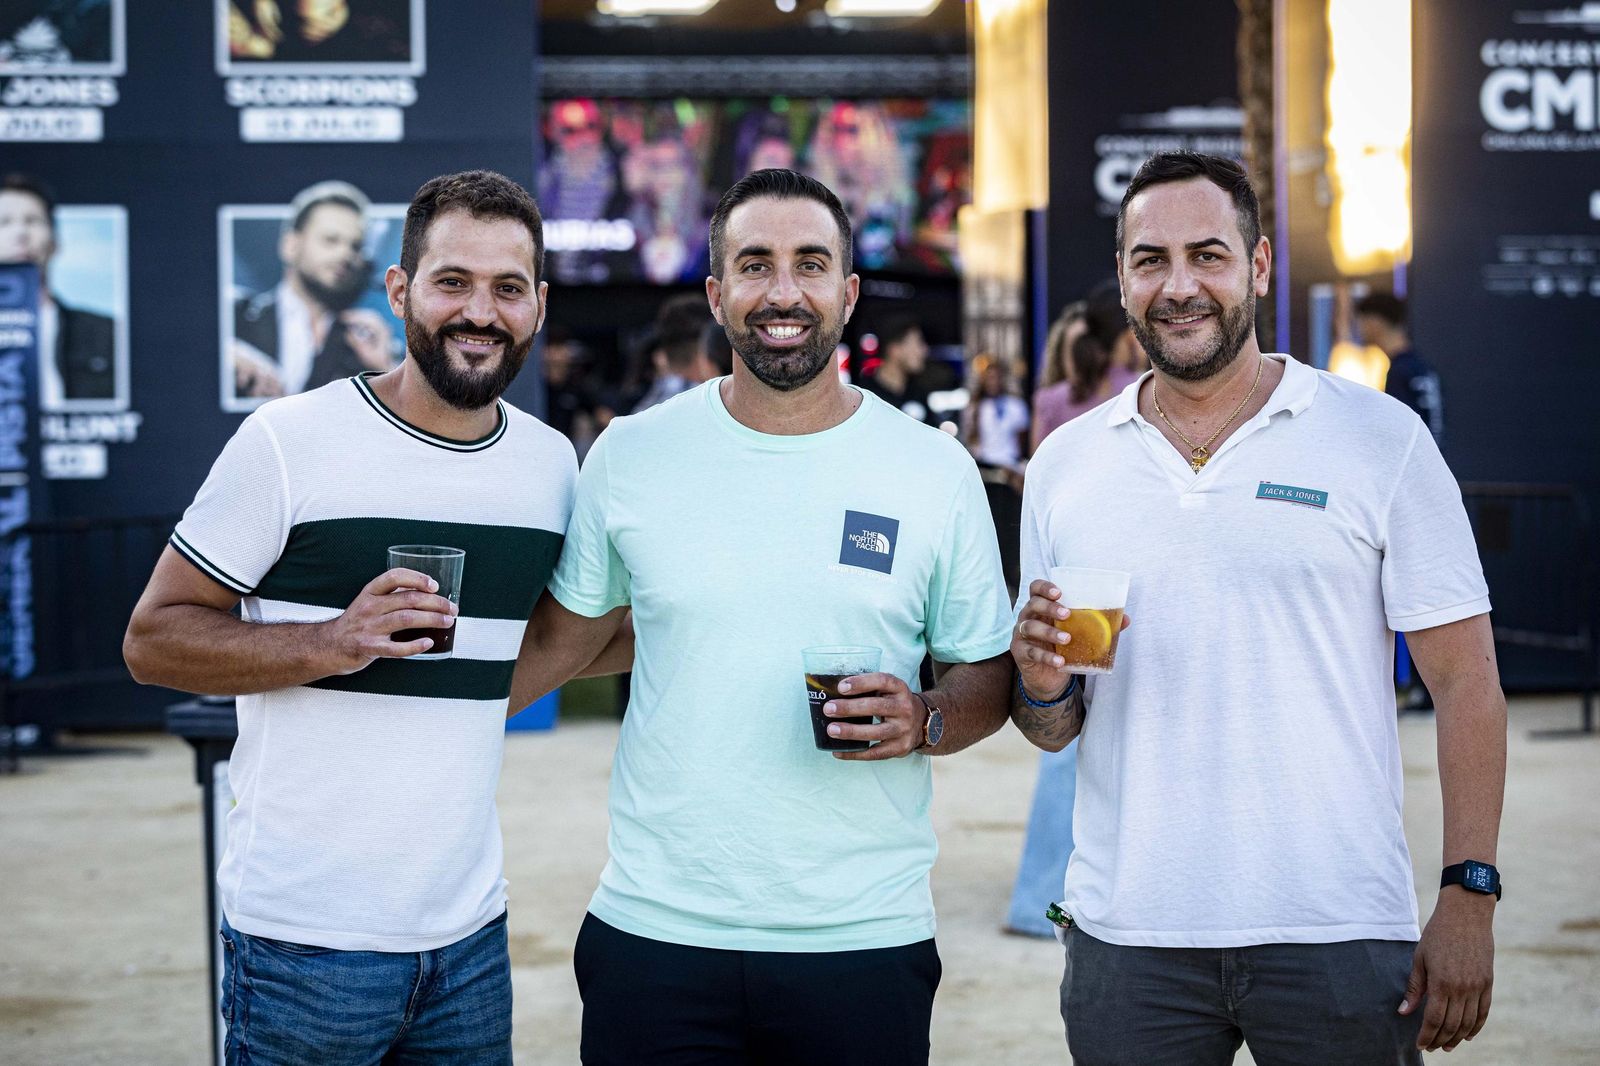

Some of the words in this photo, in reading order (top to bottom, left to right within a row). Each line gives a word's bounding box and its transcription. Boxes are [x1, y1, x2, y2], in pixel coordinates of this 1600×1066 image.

[4, 78, 119, 106] JONES
[227, 77, 418, 106] SCORPIONS
[1480, 67, 1600, 133] CM
[1264, 487, 1285, 496] JACK
[1295, 491, 1321, 502] JONES
[848, 533, 877, 546] NORTH
[862, 529, 878, 539] THE
[855, 541, 876, 552] FACE
